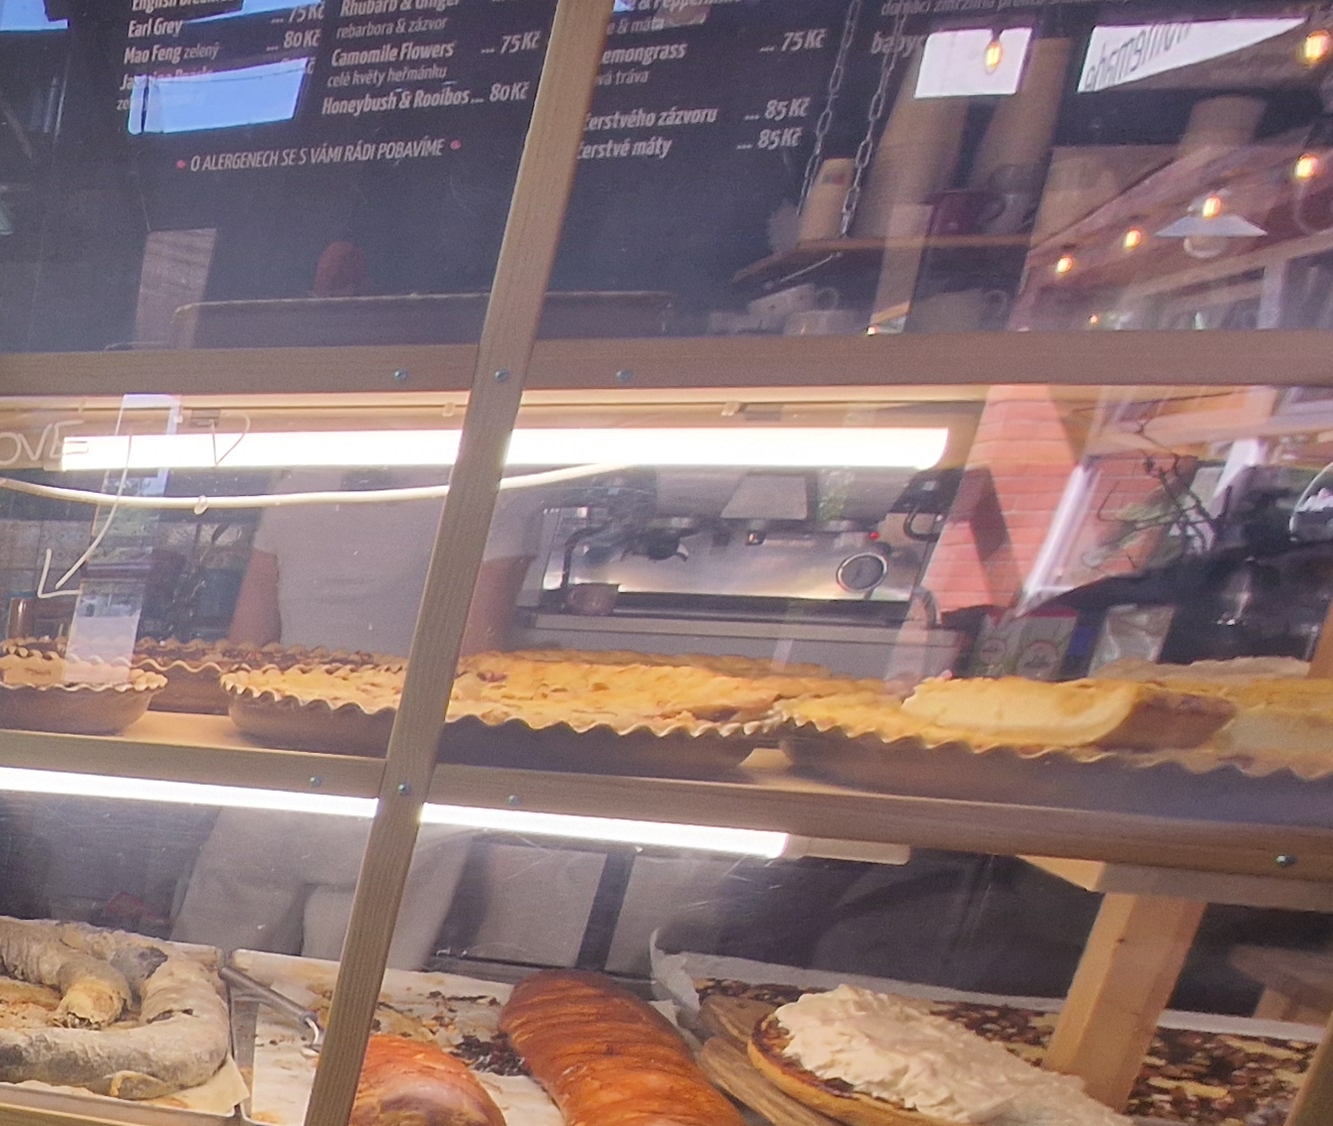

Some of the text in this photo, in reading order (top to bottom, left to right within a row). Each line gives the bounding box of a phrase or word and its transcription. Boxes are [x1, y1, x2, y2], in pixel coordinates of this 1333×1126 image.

[128, 17, 183, 37] Earl Grey
[336, 17, 448, 39] rebarbora & zázvor
[124, 44, 220, 64] Mao Feng zelený
[331, 44, 397, 67] Camomile
[399, 42, 455, 60] Flowers
[600, 43, 687, 65] emongrass
[327, 64, 448, 88] celé květy heřmánku
[615, 69, 650, 85] tráva
[322, 92, 397, 116] Honeybush
[399, 91, 411, 109] &
[658, 106, 719, 126] zázvoru
[191, 136, 445, 171] O ALERGENECH SE S VÁMI RÁDI POBAVÍME
[632, 136, 673, 159] máty
